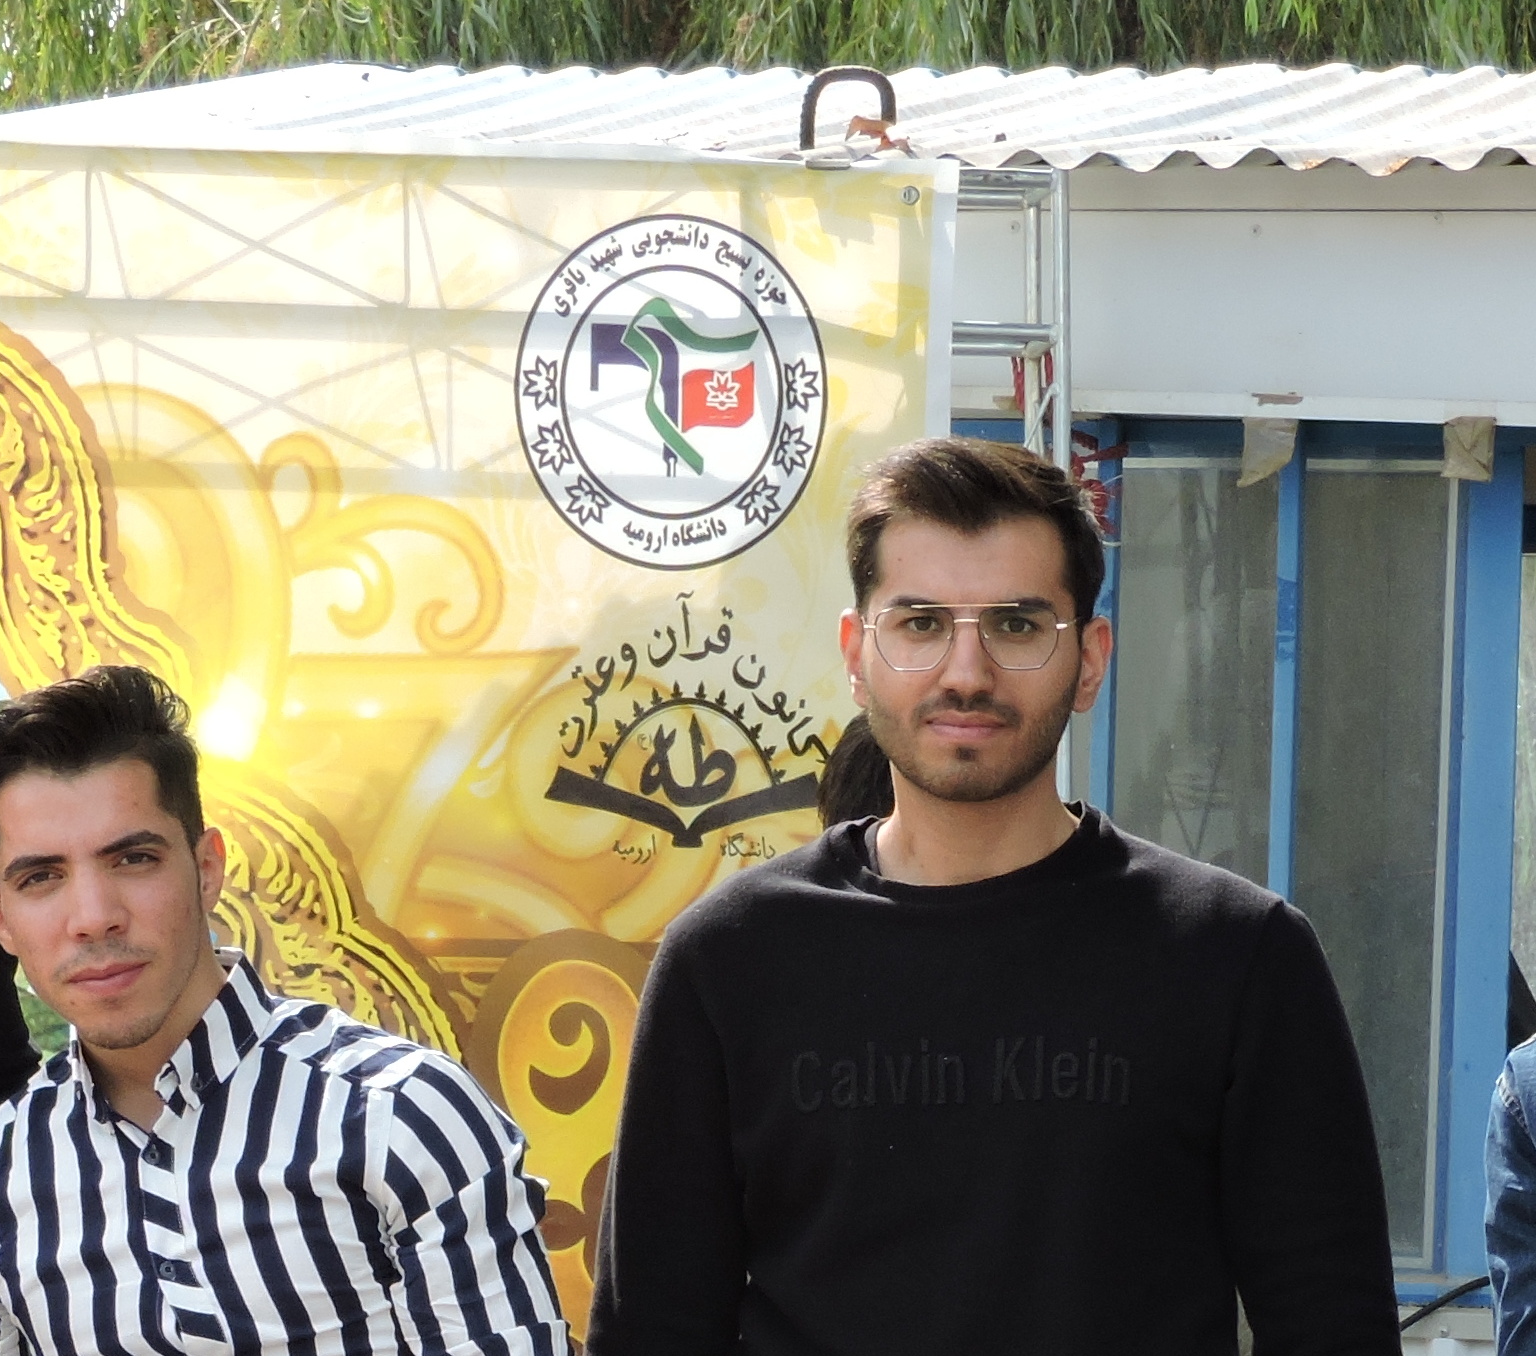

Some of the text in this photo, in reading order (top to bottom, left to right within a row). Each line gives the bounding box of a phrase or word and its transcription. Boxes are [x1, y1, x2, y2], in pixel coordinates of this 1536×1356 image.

[589, 236, 623, 272] شهید
[632, 225, 709, 258] دانشجویی
[714, 239, 753, 276] بسیج
[622, 517, 727, 553] دانشگاه ارومیه
[647, 590, 734, 668] قرآن
[612, 833, 775, 864] دانشگاه ارومیه
[791, 1035, 1131, 1113] Calvin Klein
